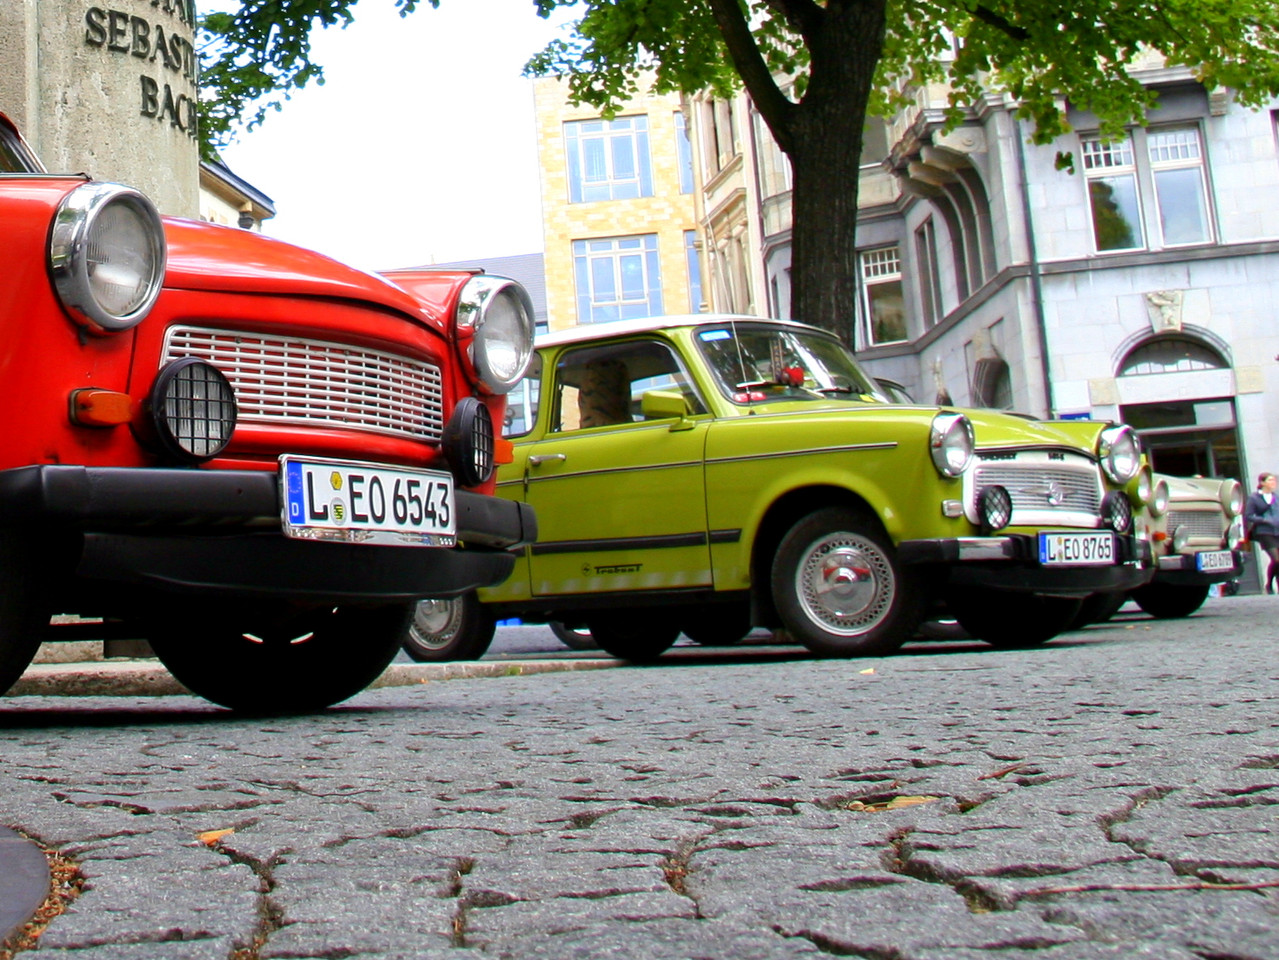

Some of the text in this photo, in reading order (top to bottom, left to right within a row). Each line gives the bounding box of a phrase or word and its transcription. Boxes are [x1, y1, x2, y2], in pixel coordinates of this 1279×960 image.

[139, 74, 198, 141] BACH
[291, 502, 299, 517] D
[306, 471, 450, 528] L EO 6543
[1047, 537, 1111, 561] L EO 8765
